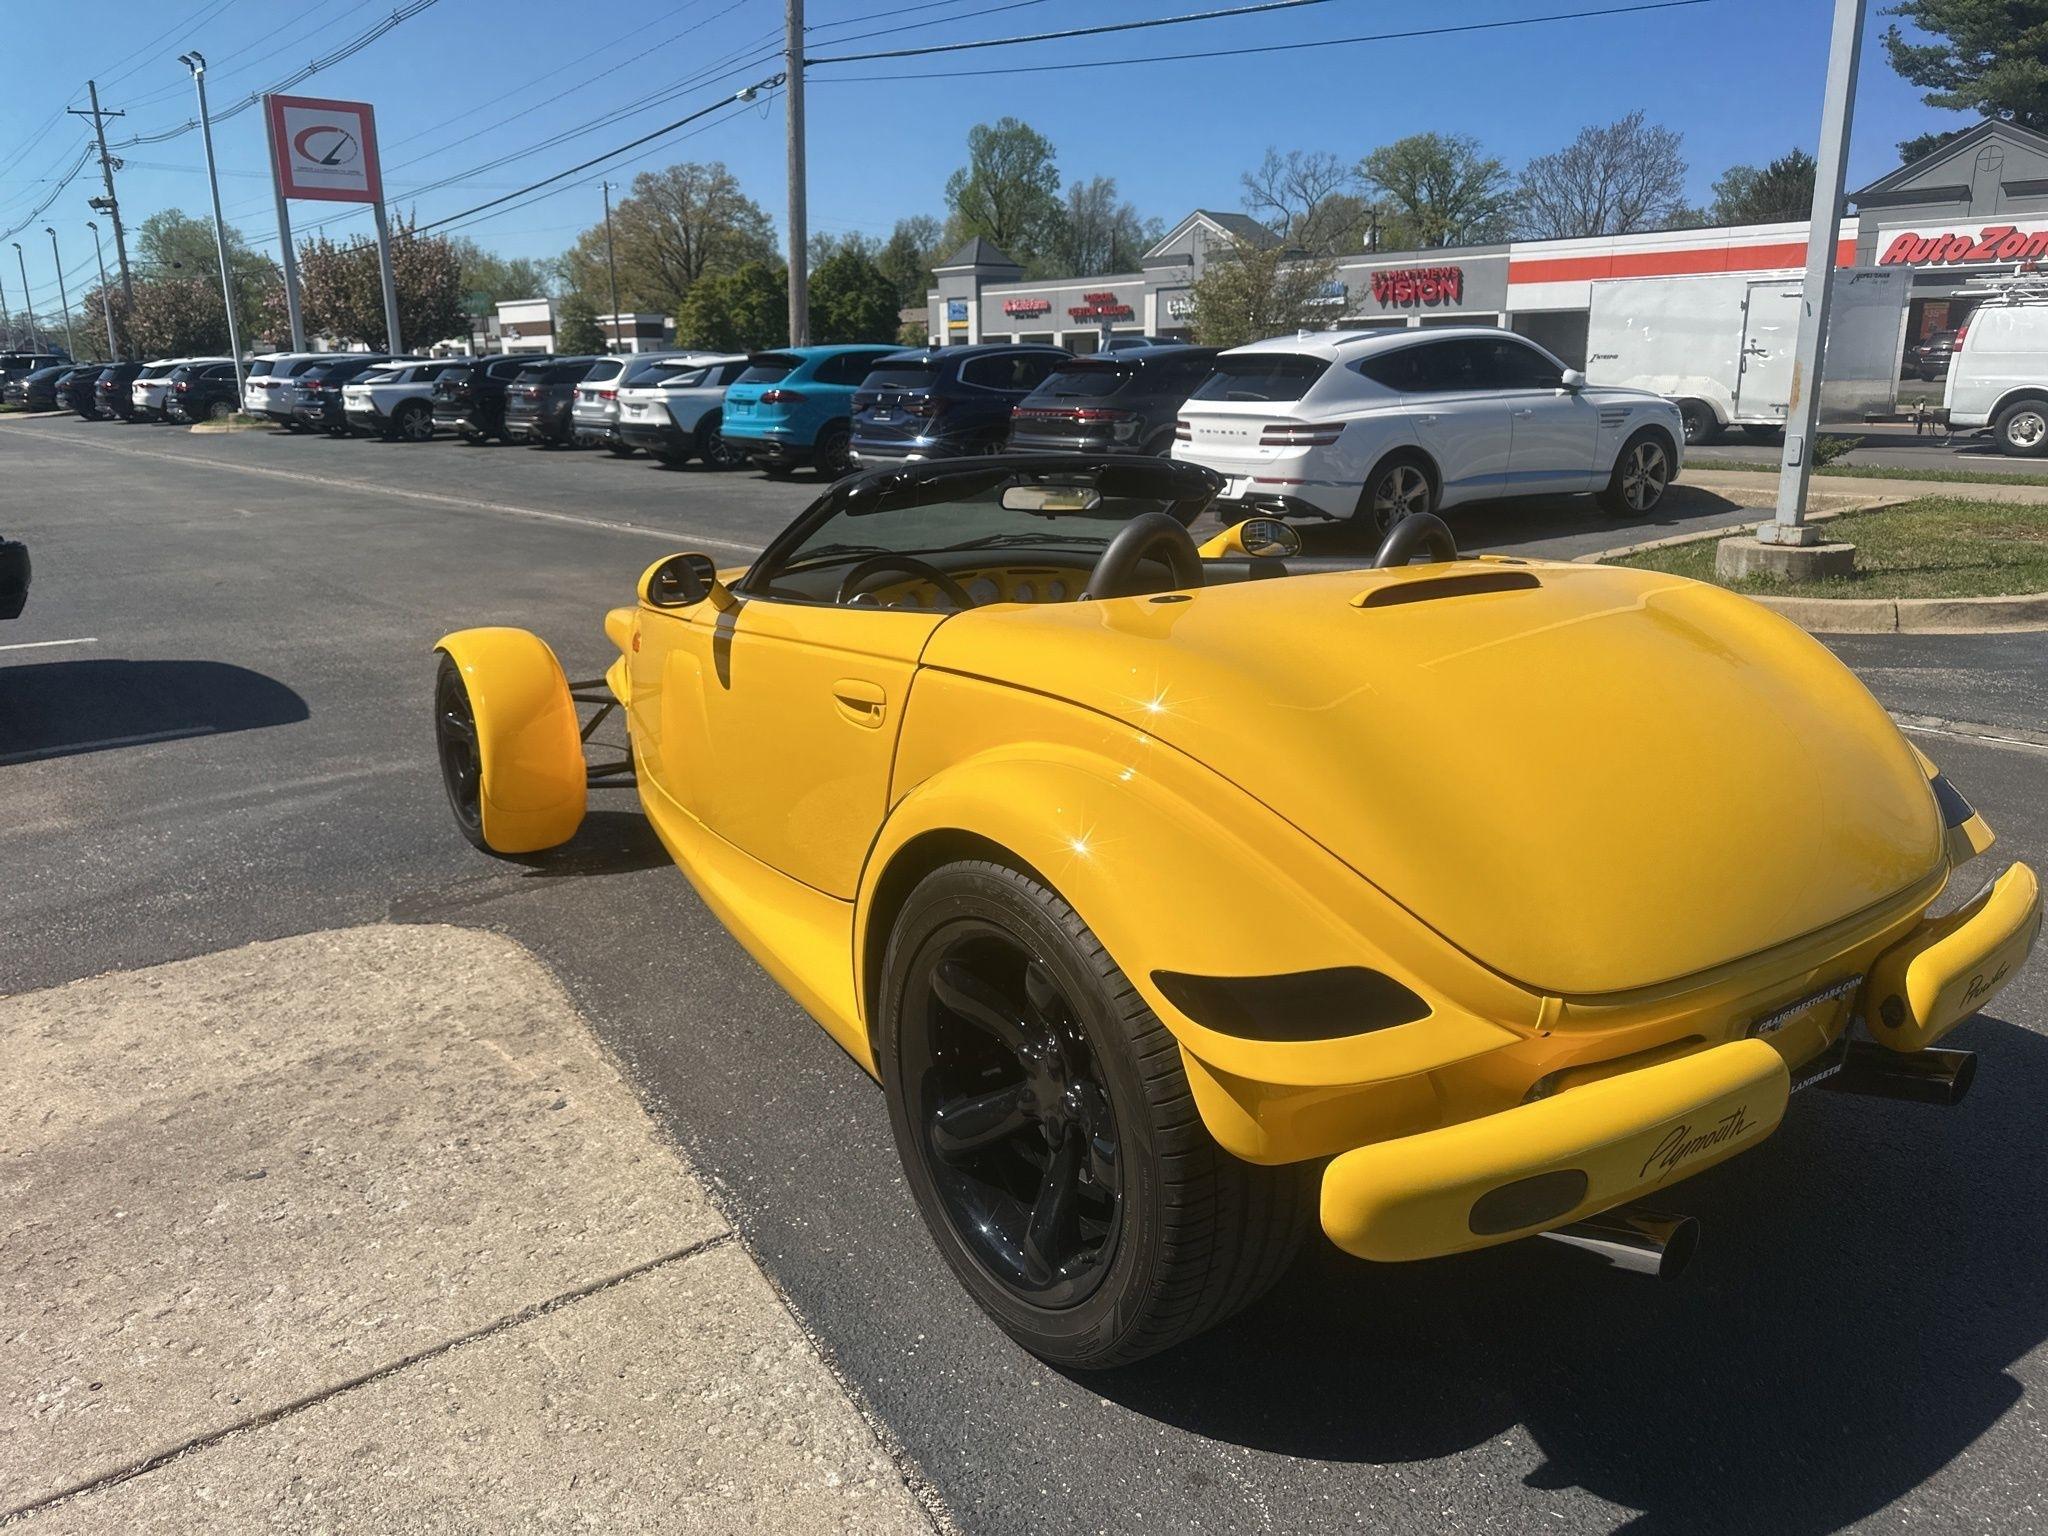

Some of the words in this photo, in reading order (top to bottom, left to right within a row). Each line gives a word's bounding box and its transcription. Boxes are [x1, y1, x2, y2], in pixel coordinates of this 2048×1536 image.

[1879, 225, 2048, 265] AutoZon
[1372, 278, 1460, 303] VISION
[1789, 1063, 1842, 1095] LANDRETH
[1639, 1104, 1757, 1183] Plymouth
